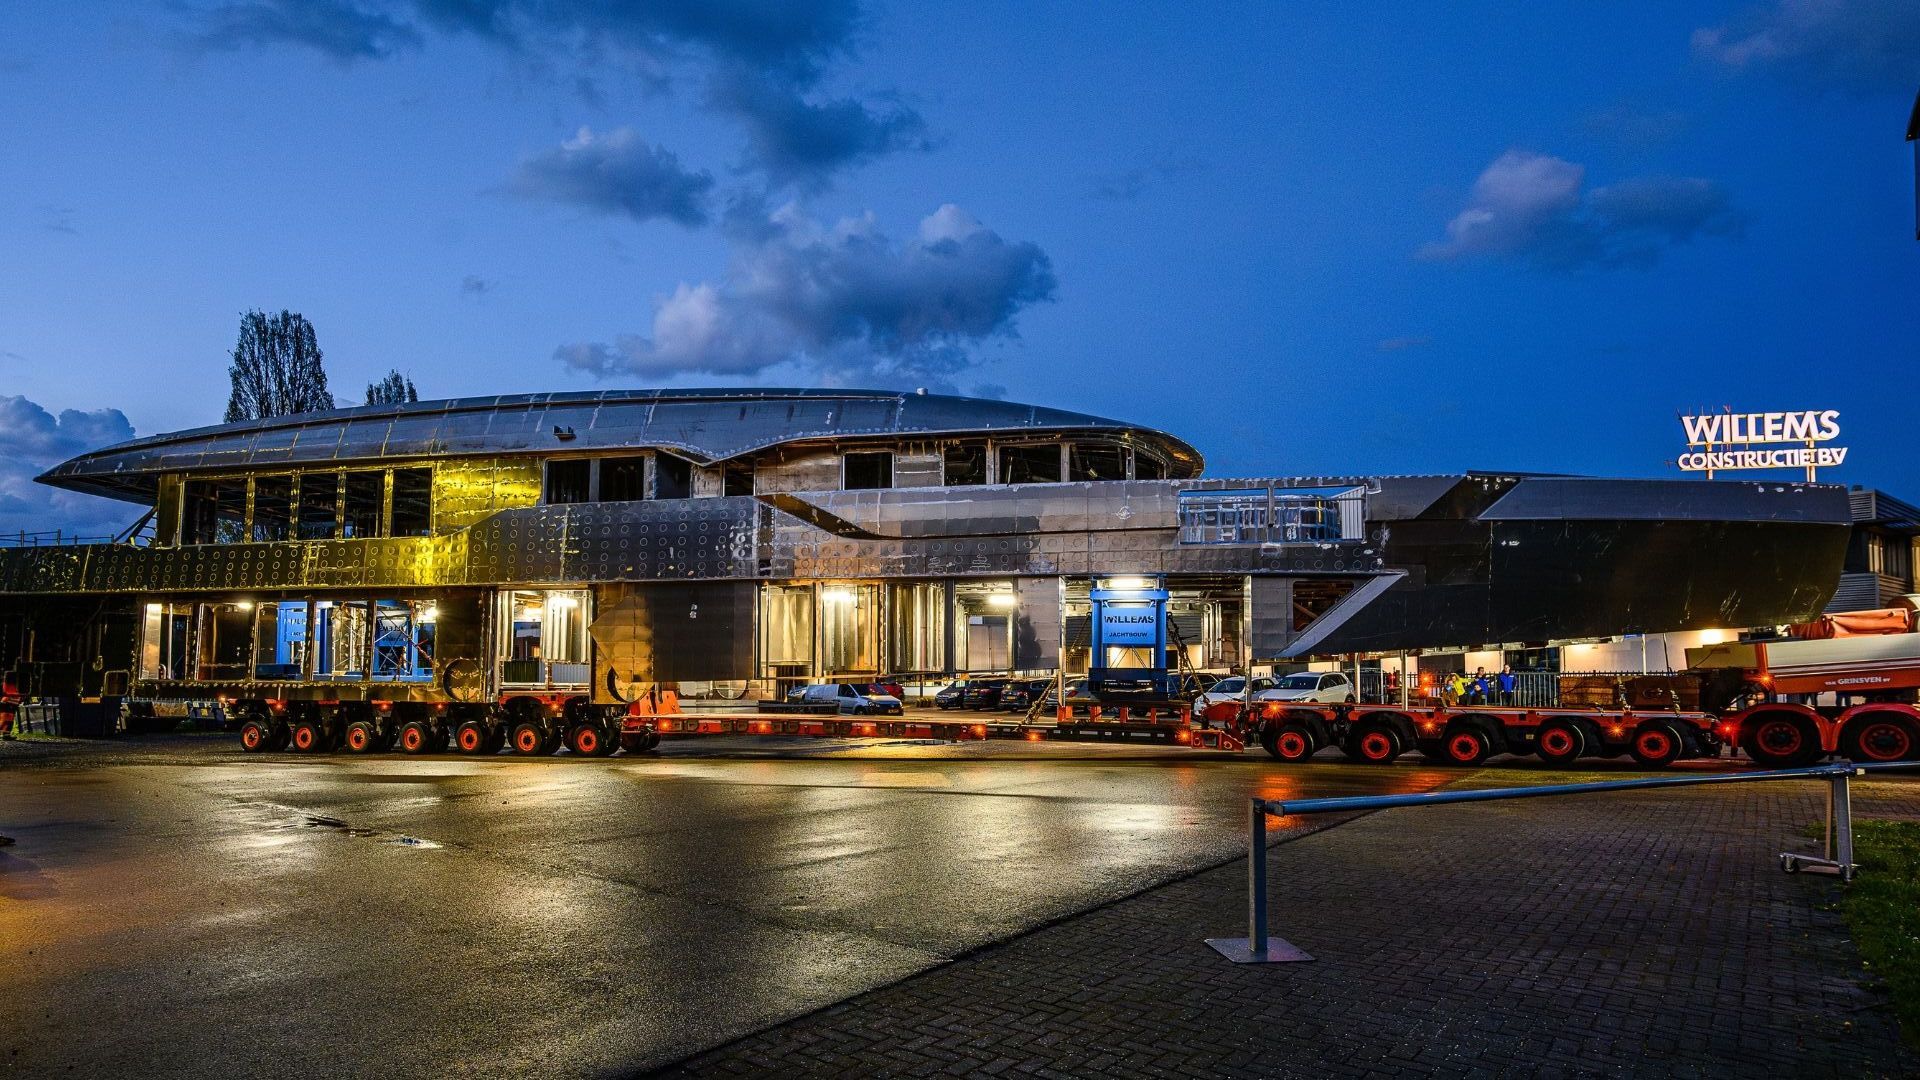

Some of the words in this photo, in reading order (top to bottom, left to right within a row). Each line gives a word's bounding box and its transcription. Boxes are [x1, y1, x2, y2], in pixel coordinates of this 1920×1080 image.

[1682, 410, 1841, 444] WILLEMS
[1677, 449, 1813, 470] CONSTRUCTIE
[1818, 447, 1849, 466] BV
[1104, 615, 1154, 623] WILLEMS
[1838, 676, 1881, 684] GRINSVEN
